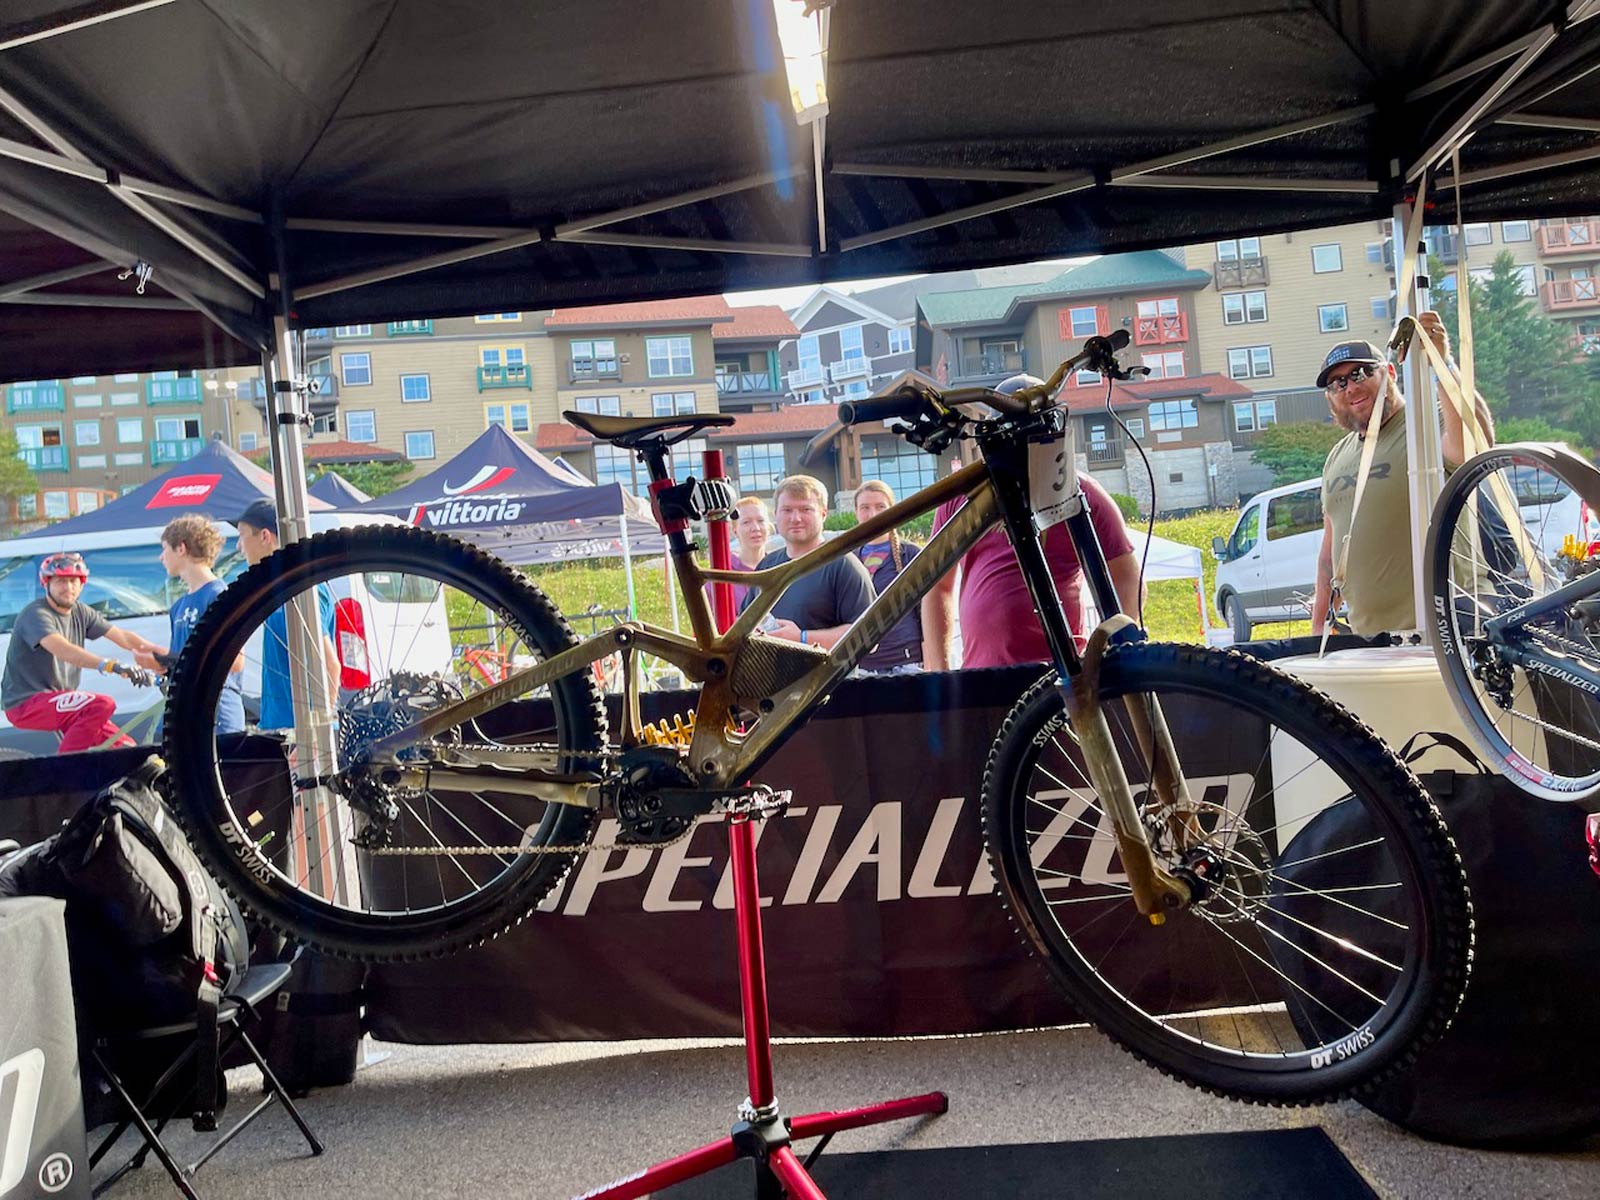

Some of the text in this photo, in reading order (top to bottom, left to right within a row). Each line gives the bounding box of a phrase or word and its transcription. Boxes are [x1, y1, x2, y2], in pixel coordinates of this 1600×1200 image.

[1052, 452, 1067, 491] 3
[426, 499, 522, 526] vittoria
[1434, 594, 1455, 655] DT SWISS
[1525, 659, 1599, 694] SPECIALIZED
[1032, 714, 1063, 748] SWISS
[219, 821, 276, 884] DT SWISS
[519, 773, 1255, 916] PECIALZED
[1310, 1026, 1376, 1070] DT SWISS
